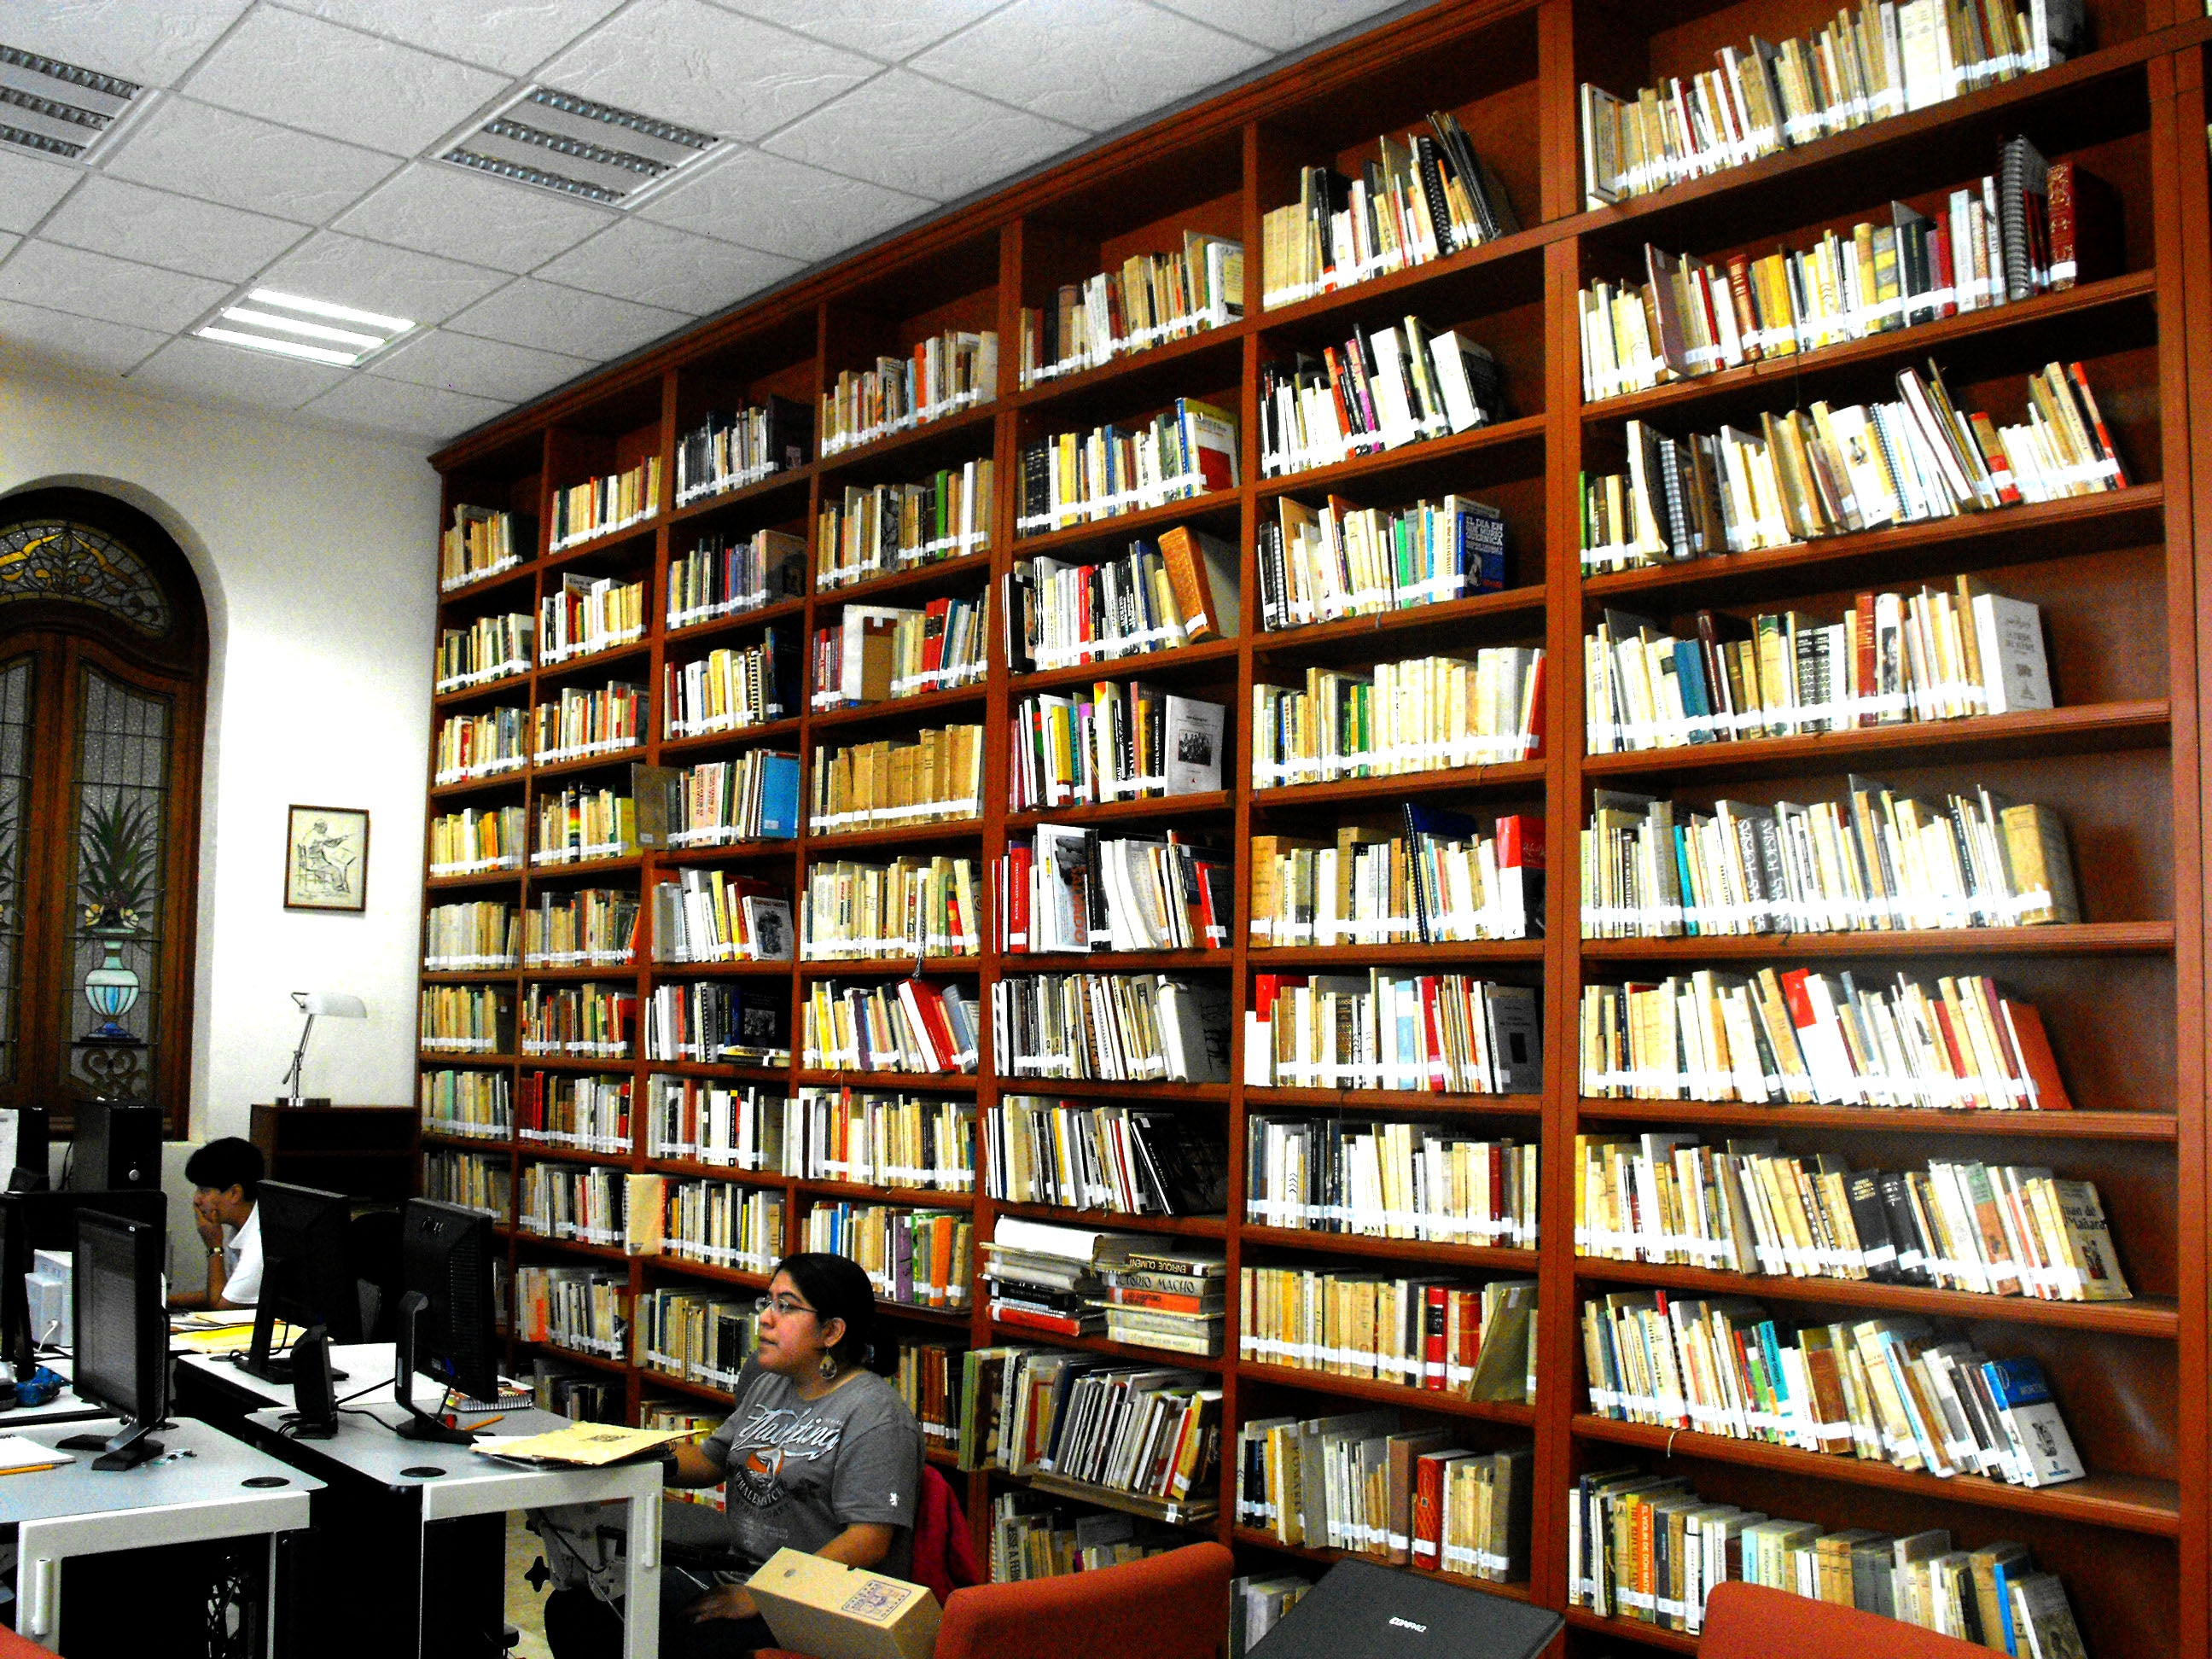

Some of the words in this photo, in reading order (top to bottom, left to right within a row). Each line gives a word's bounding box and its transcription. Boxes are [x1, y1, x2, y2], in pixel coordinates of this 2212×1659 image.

[1466, 515, 1475, 525] EL
[1476, 518, 1489, 527] DIA
[1491, 521, 1504, 530] EN
[1158, 1260, 1186, 1273] ENRIQUE
[1157, 1278, 1195, 1294] MACHO
[1642, 1505, 1649, 1515] EL
[1642, 1541, 1649, 1552] DE
[1388, 1616, 1427, 1633] COMPAQ
